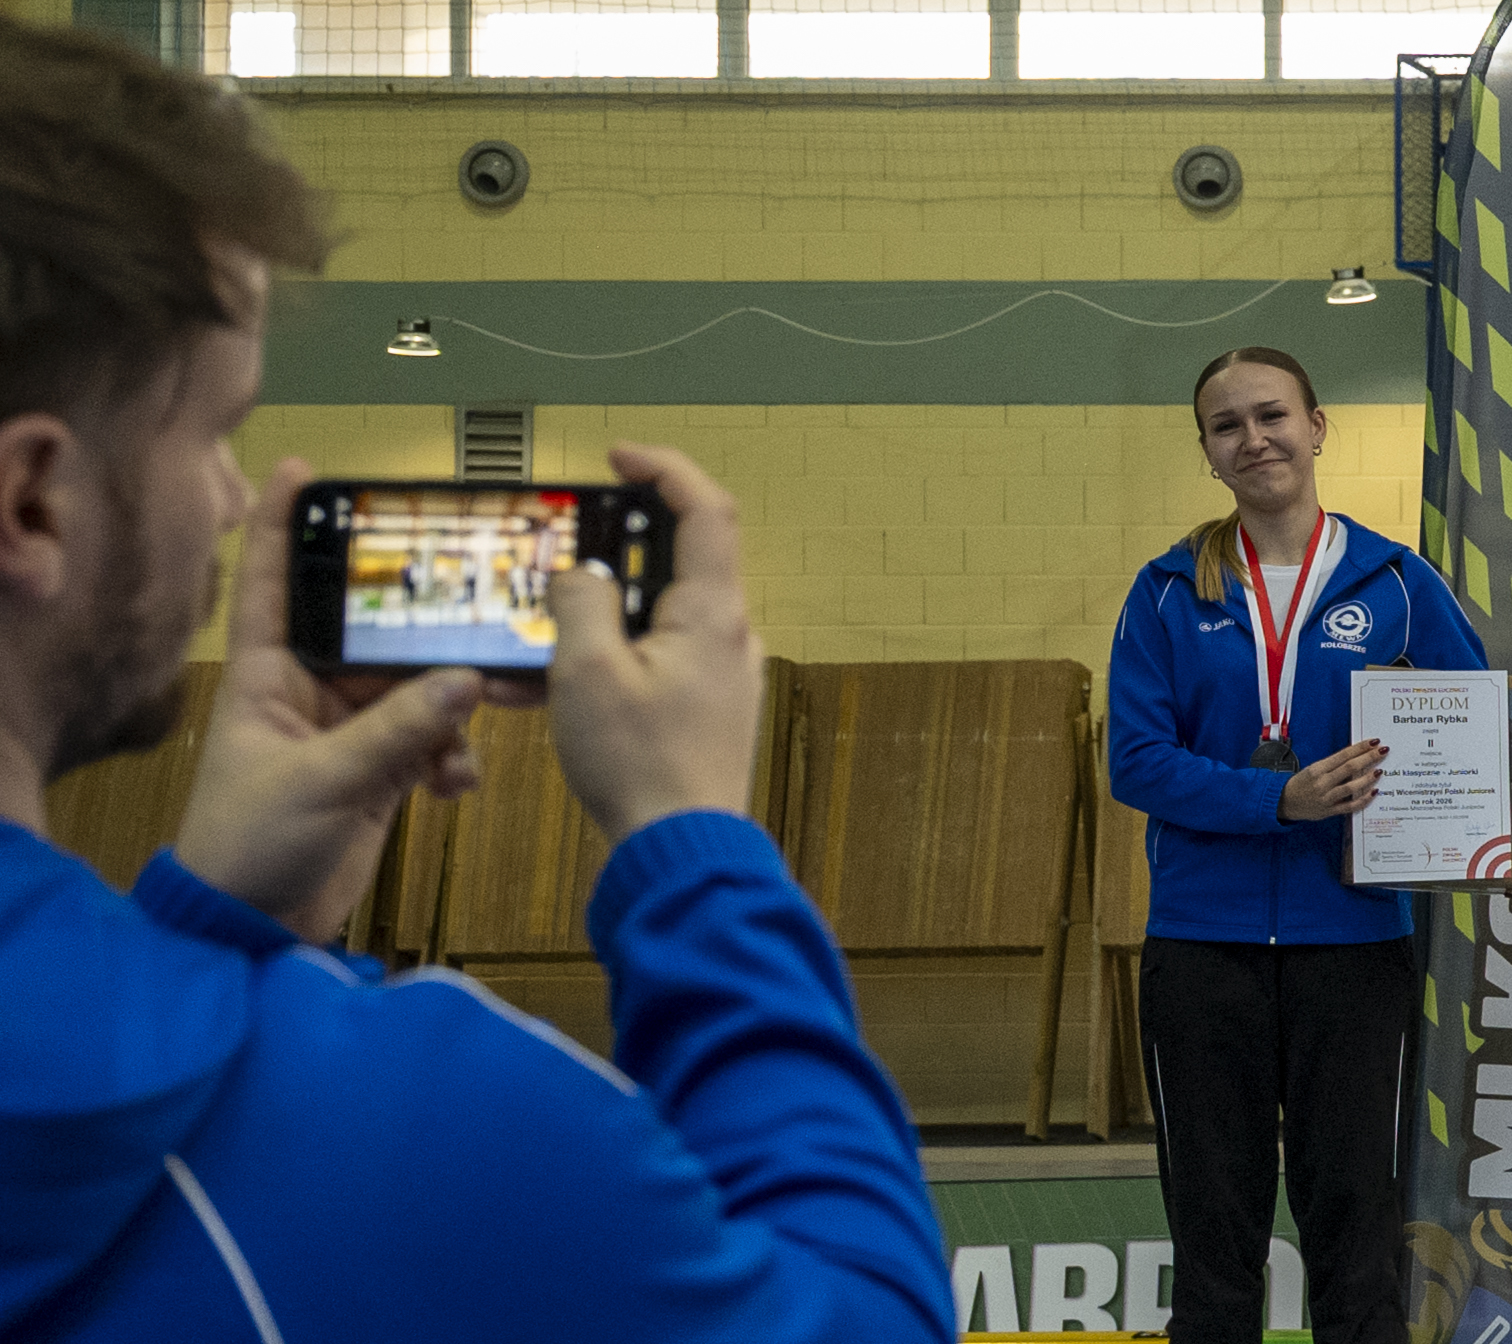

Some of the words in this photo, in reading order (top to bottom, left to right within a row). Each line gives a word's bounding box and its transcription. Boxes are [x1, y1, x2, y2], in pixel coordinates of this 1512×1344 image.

[1392, 696, 1470, 711] DYPLOM
[1393, 715, 1434, 725] Barbara
[1436, 715, 1469, 726] Rybka
